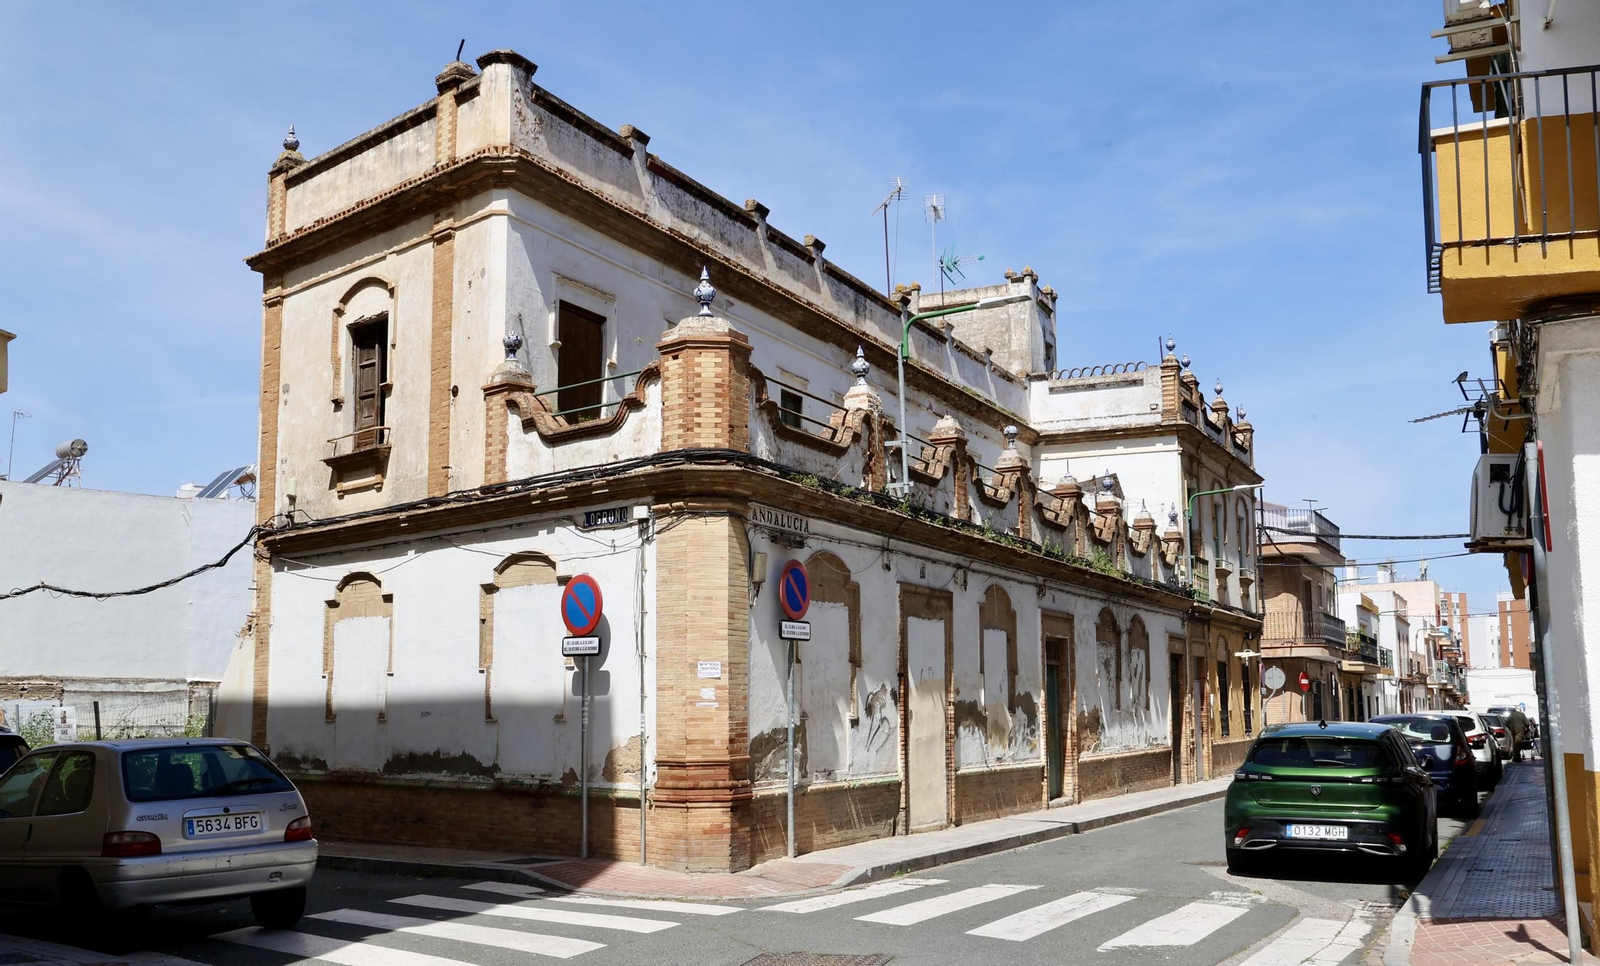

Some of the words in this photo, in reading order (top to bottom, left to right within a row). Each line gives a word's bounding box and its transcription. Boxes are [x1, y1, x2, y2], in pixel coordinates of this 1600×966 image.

[195, 817, 231, 833] 5634
[235, 815, 258, 830] BFG
[1294, 825, 1321, 837] 0132
[1324, 826, 1345, 837] MGH
